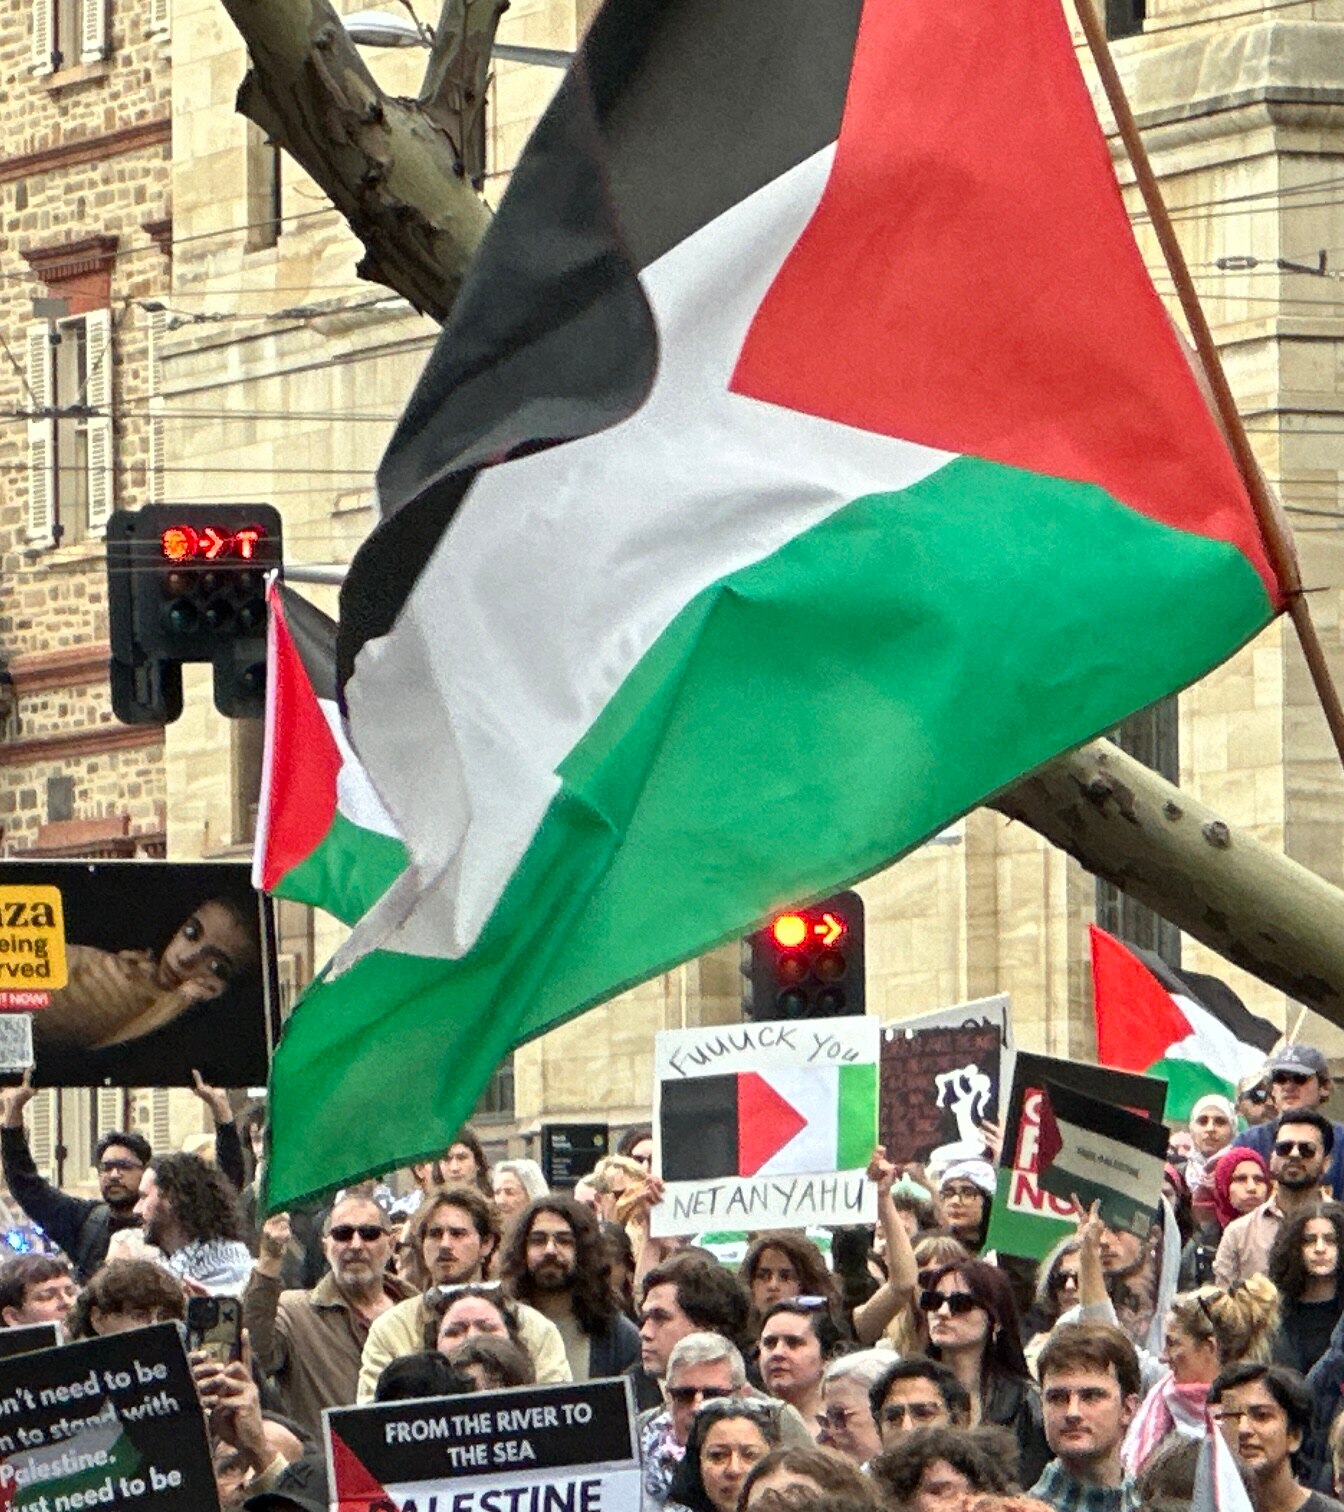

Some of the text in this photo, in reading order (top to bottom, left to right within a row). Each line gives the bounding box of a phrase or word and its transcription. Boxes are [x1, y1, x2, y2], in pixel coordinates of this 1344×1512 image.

[672, 1178, 865, 1220] NETANYAHU
[40, 1370, 101, 1408] need
[103, 1366, 132, 1392] to
[133, 1359, 169, 1383] be
[18, 1426, 47, 1450] to
[50, 1402, 119, 1441] stand
[123, 1391, 181, 1424] with
[385, 1402, 594, 1445] FROM THE RIVER TO
[447, 1438, 538, 1470] THE SEA
[118, 1472, 148, 1500] to
[150, 1466, 184, 1492] be
